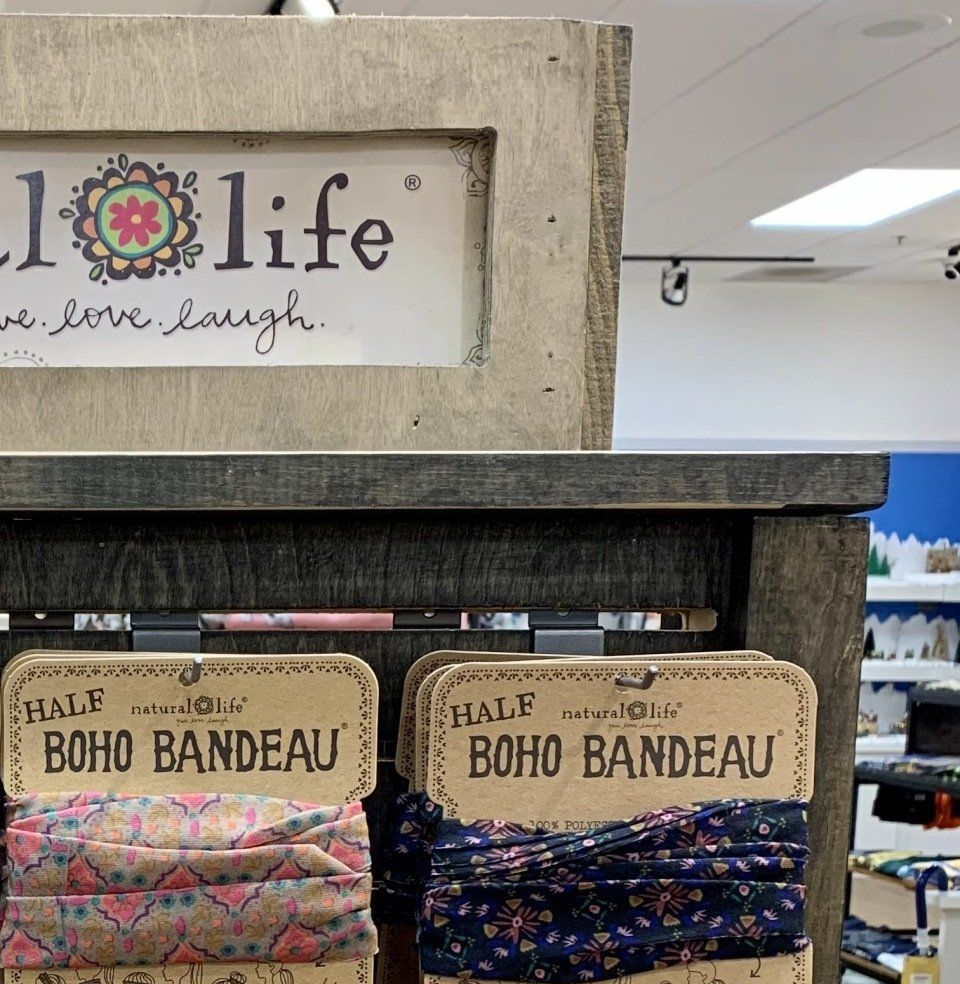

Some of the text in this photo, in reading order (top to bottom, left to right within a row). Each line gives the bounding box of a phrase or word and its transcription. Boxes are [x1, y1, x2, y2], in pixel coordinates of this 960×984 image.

[22, 688, 105, 724] HALF
[131, 698, 193, 715] natural
[449, 692, 537, 728] HALF
[561, 702, 625, 721] natural
[43, 730, 133, 773] BOHO
[468, 733, 561, 779] BOHO
